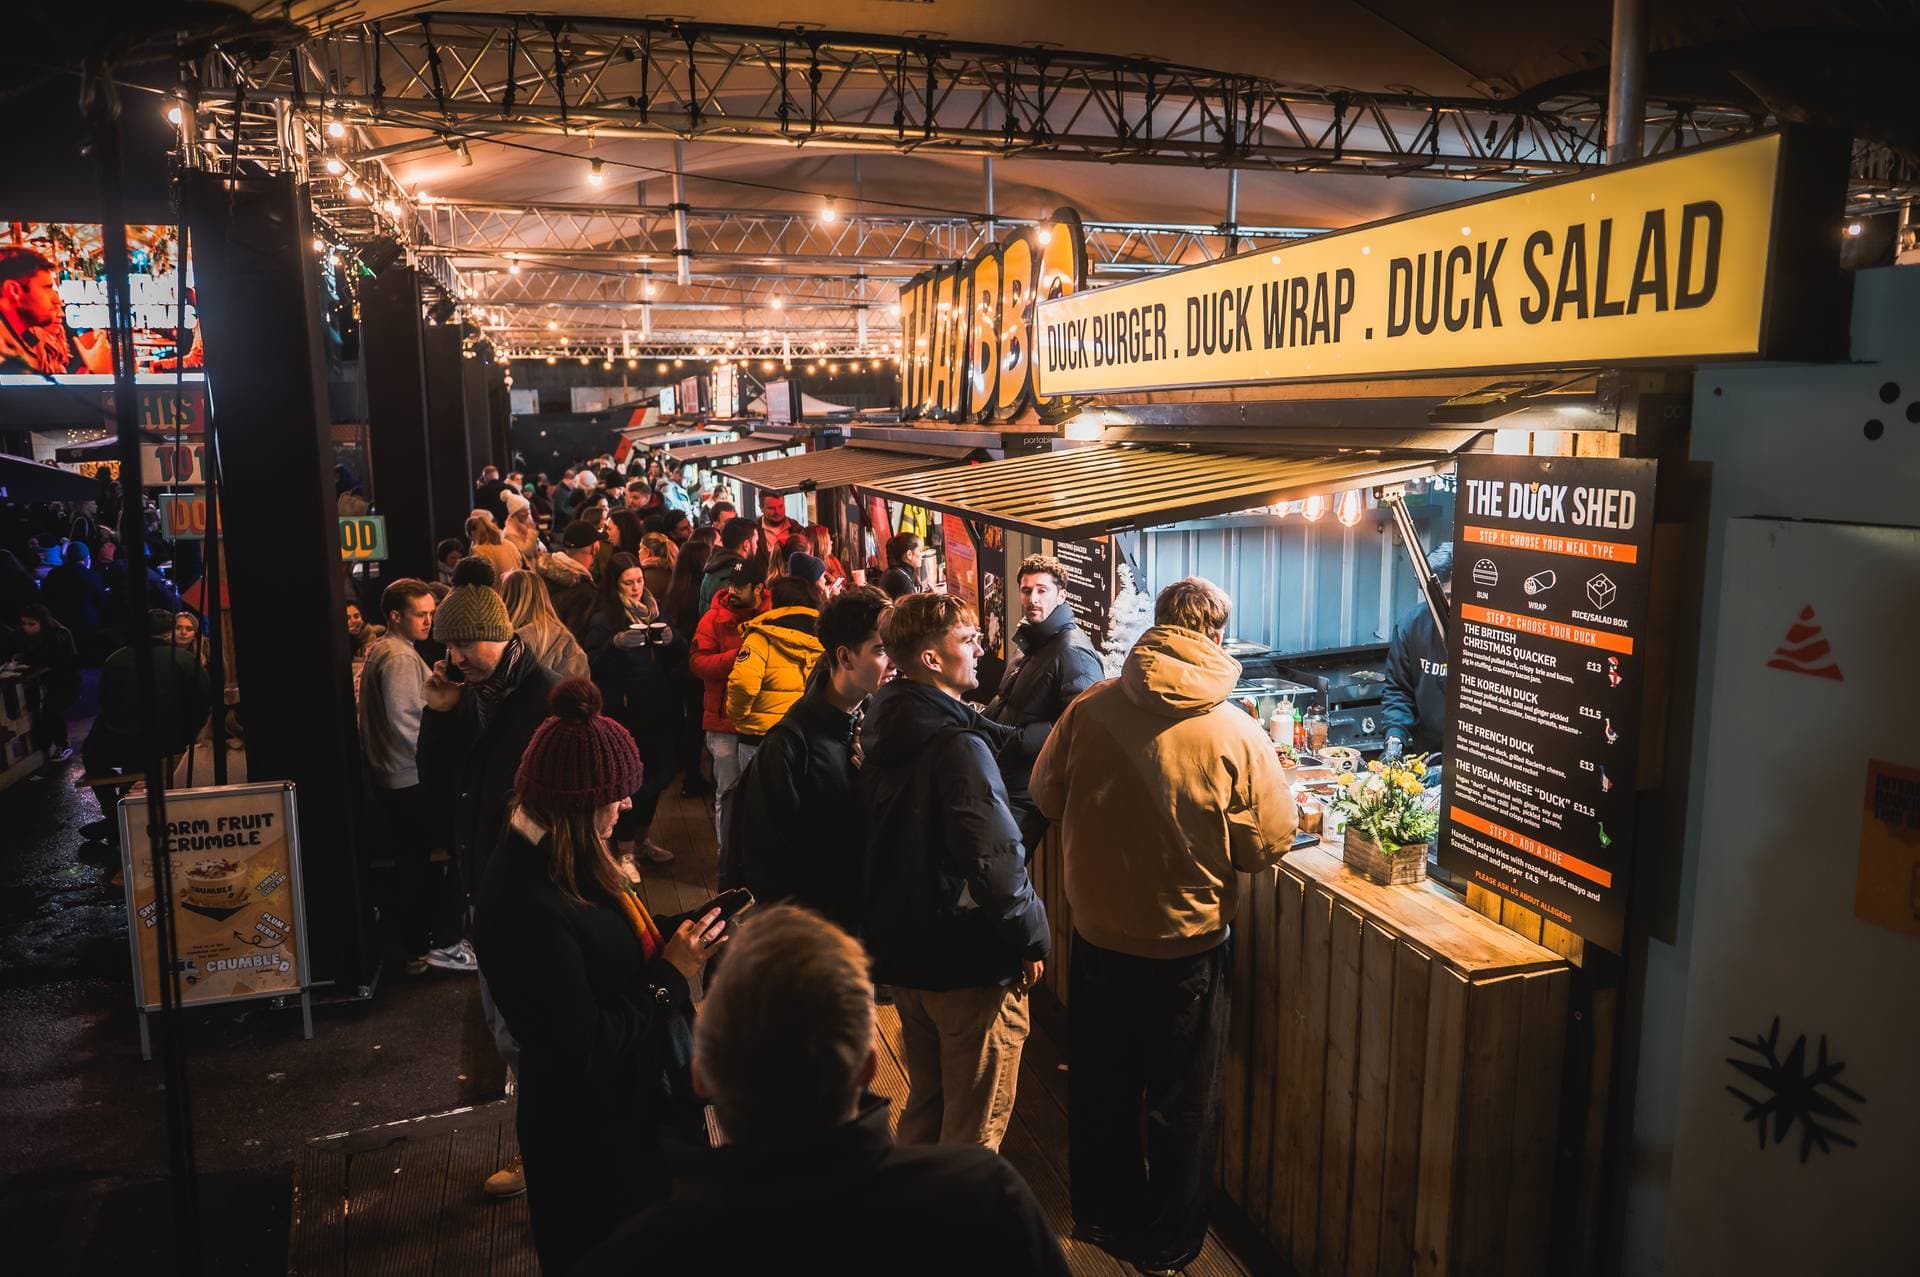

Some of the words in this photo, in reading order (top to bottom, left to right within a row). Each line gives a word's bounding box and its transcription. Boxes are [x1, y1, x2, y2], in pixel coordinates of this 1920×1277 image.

[1048, 317, 1088, 372] DUCK
[1092, 303, 1167, 367] BURGER
[1186, 285, 1254, 357] DUCK
[1260, 267, 1355, 350] WRAP
[1386, 237, 1508, 337] DUCK
[1518, 200, 1725, 325] SALAD
[1466, 479, 1504, 517] THE
[1508, 481, 1568, 524] DUCK
[1571, 486, 1636, 530] SHED
[1479, 529, 1497, 543] STEP
[1500, 532, 1508, 544] 1:
[1509, 533, 1539, 548] CHOOSE
[1542, 537, 1563, 552] YOUR
[1566, 540, 1589, 555] MEAL
[1591, 543, 1614, 558] TYPE
[1476, 590, 1488, 600] BUN
[1527, 600, 1547, 612] WRAP
[1486, 611, 1505, 626] STEP
[1506, 615, 1513, 628] 2:
[1516, 617, 1545, 634] CHOOSE
[1549, 624, 1570, 640] YOUR
[1573, 629, 1596, 645] DUCK
[1571, 609, 1612, 626] RICE/SALAD
[1612, 617, 1628, 628] BOX
[1463, 622, 1479, 636] THE
[1481, 626, 1516, 644] BRITISH
[1462, 634, 1512, 656] CHRISTMAS
[1512, 646, 1557, 669] QUACKER
[1586, 660, 1602, 673] £13
[1460, 673, 1476, 687] THE
[1476, 677, 1512, 697] KOREAN
[1513, 687, 1538, 704] DUCK
[1578, 705, 1602, 720] £11.5
[1457, 719, 1473, 734] THE
[1474, 725, 1508, 745] FRENCH
[1508, 736, 1534, 754] DUCK
[1579, 758, 1594, 772] £13
[1455, 758, 1470, 773] THE
[1471, 764, 1532, 796] VEGAN-AMESE
[1573, 801, 1595, 817] £11.5
[147, 819, 209, 838] ARM
[217, 812, 274, 831] FRUIT
[167, 831, 261, 853] CRUMBLE
[1489, 824, 1507, 841] STEP
[1509, 832, 1516, 845] 3:
[1519, 837, 1535, 853] ADD
[1536, 844, 1541, 856] A
[1544, 847, 1562, 864] SIDE
[1476, 839, 1496, 856] potato
[1495, 847, 1509, 860] fries
[1509, 853, 1524, 867] with
[1524, 860, 1548, 879] roasted
[1548, 871, 1567, 888] garlic
[1567, 880, 1586, 897] mayo
[1586, 888, 1600, 902] and
[1524, 871, 1539, 885] £4.5
[1475, 869, 1497, 887] PLEASE
[1497, 879, 1510, 893] ASK
[1510, 886, 1519, 897] US
[1519, 890, 1540, 907] ABOUT
[254, 922, 281, 941] BERRY
[262, 911, 283, 929] PLUM
